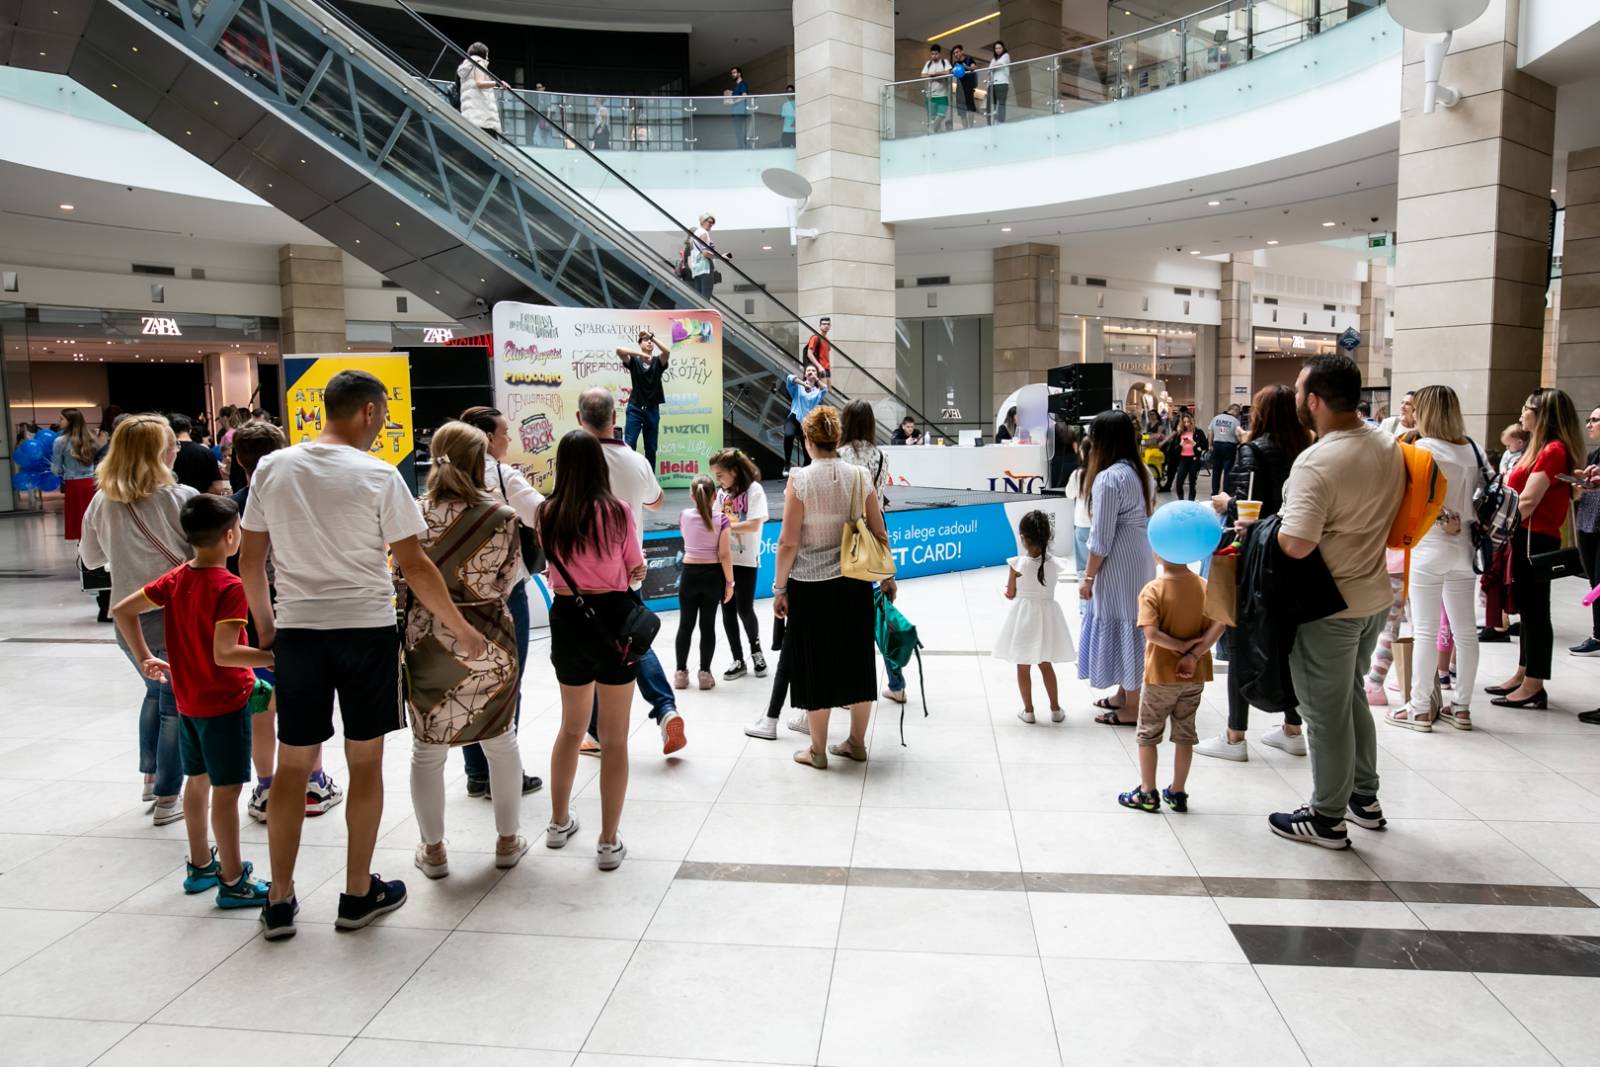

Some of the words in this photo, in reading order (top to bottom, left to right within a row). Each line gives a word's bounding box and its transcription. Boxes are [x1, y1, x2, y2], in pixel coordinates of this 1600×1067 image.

[141, 316, 183, 336] ZARA
[423, 327, 454, 343] ZARA
[503, 371, 563, 387] PINOCCHIO
[661, 365, 713, 385] OROTHY
[522, 430, 555, 452] ROCK
[660, 460, 699, 475] Heidi
[986, 475, 1045, 495] ING
[904, 524, 936, 542] alege
[938, 519, 978, 536] cadoul!
[889, 547, 909, 566] FT
[911, 541, 962, 564] CARD!
